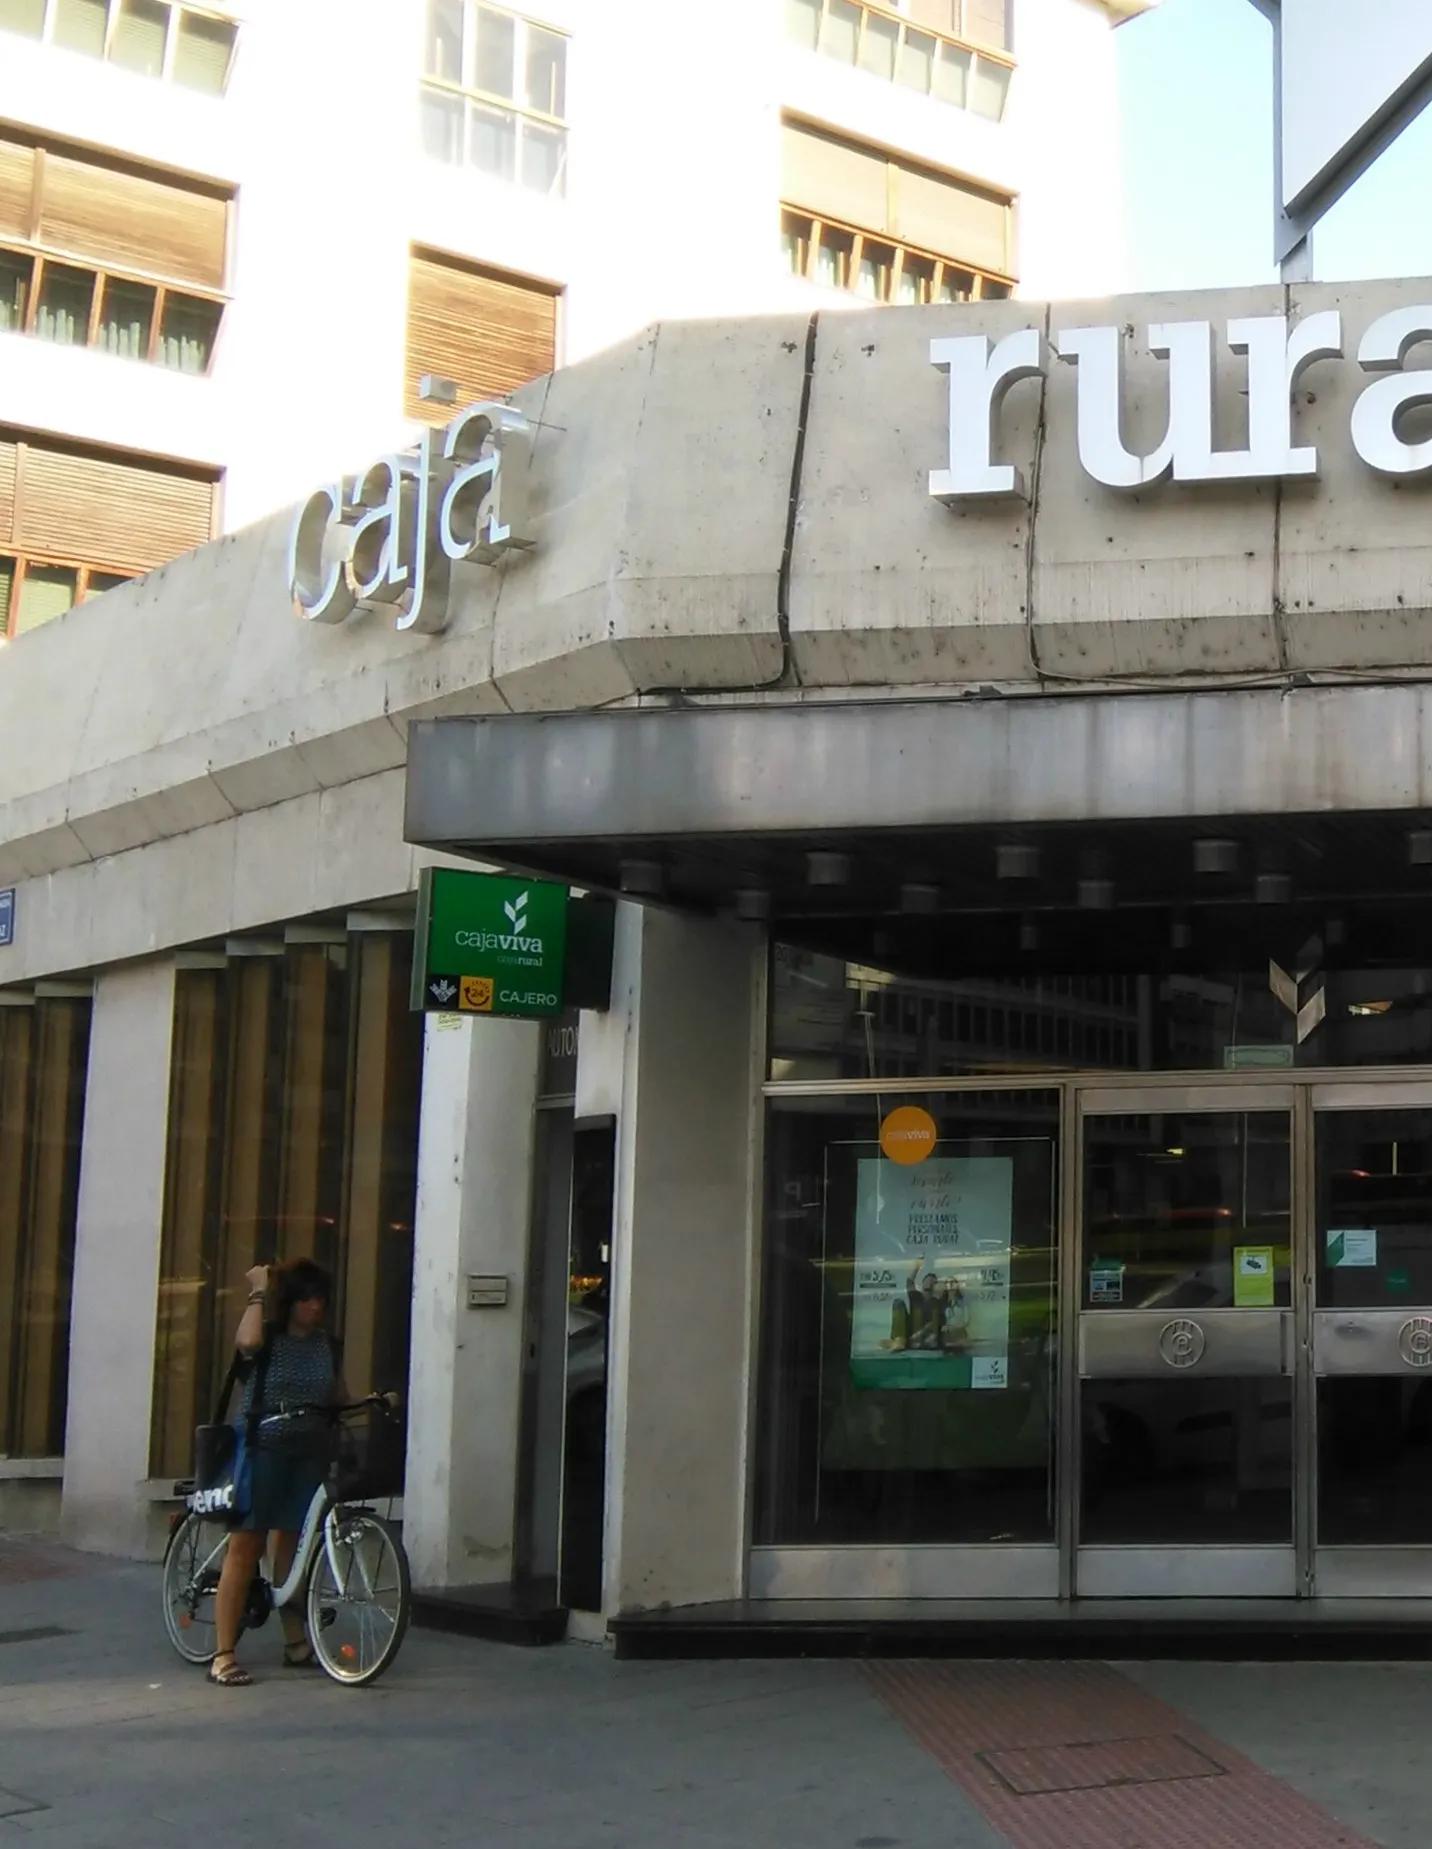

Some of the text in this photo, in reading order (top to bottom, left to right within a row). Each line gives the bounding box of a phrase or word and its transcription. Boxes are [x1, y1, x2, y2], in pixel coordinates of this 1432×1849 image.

[288, 400, 524, 630] caja
[454, 928, 544, 954] cajaviva
[499, 990, 557, 1006] CAJERO
